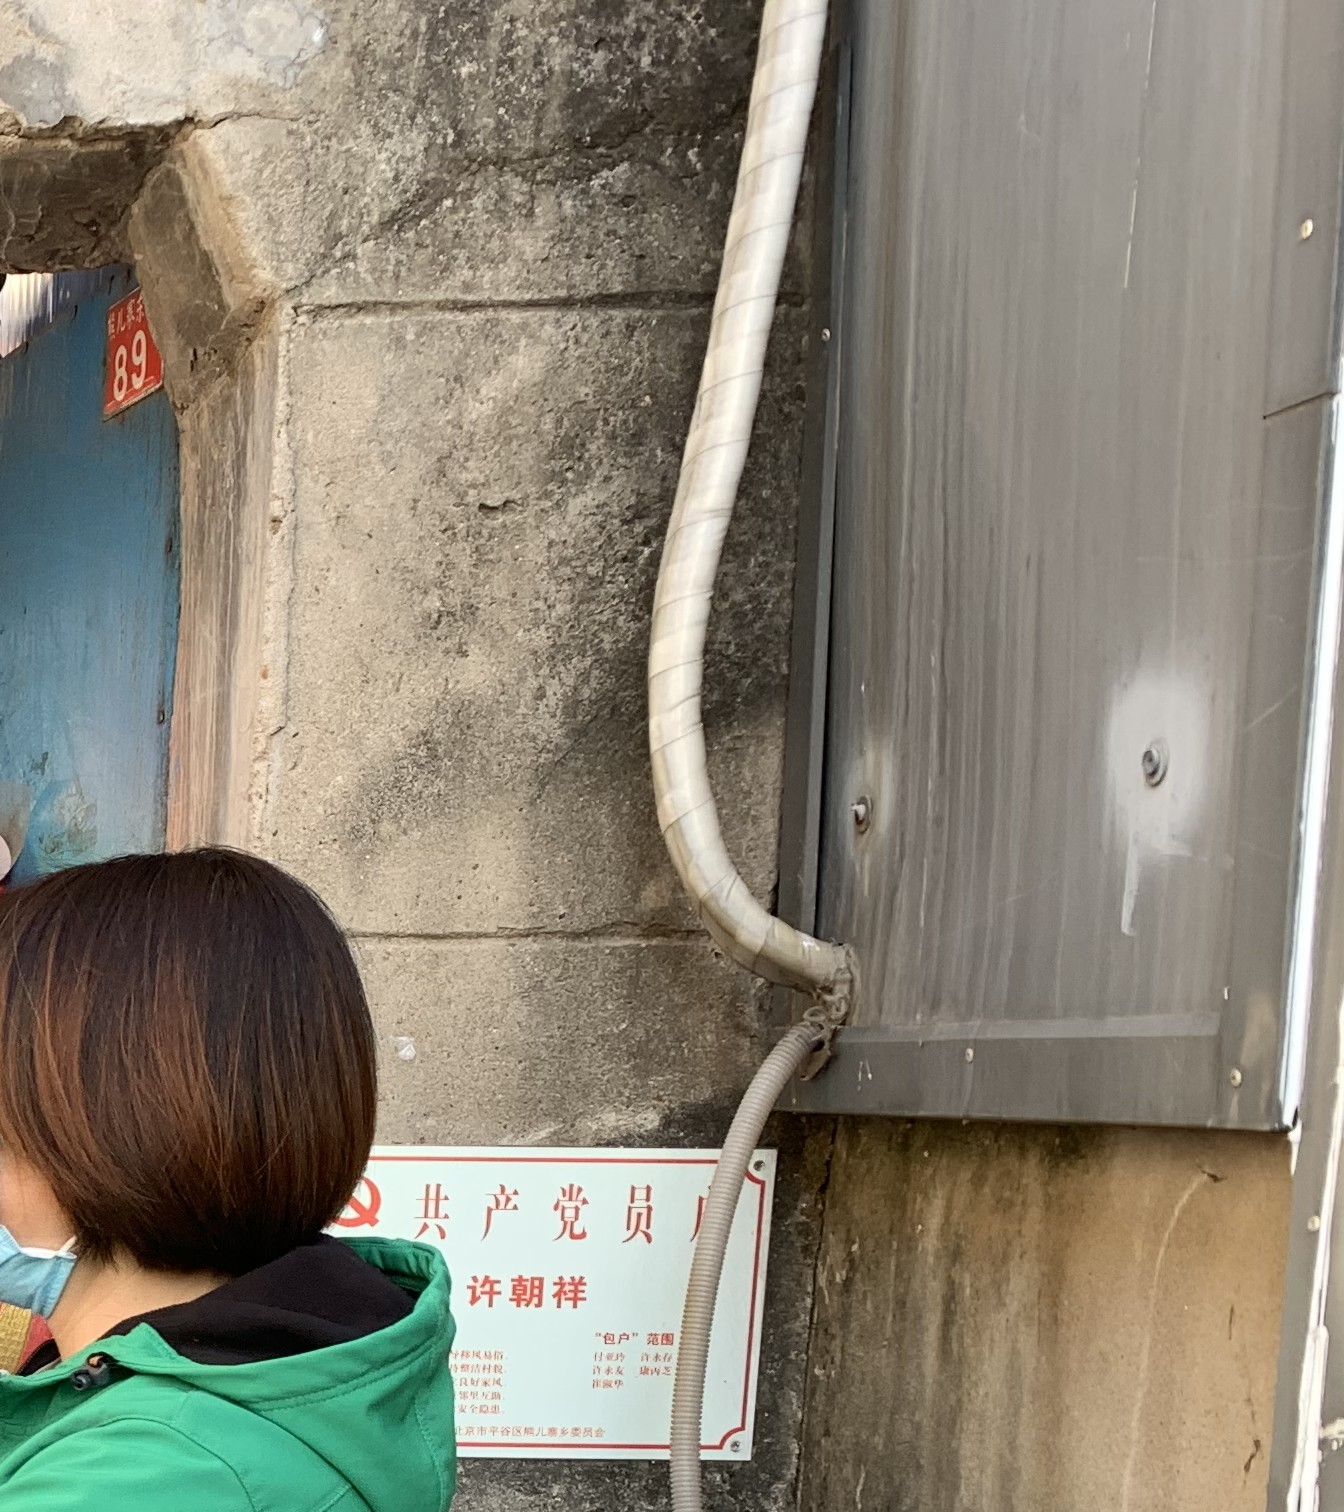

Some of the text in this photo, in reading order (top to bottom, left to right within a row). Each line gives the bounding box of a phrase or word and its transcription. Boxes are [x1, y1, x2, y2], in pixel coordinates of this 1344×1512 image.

[113, 330, 147, 401] 89
[467, 1275, 587, 1309] 许朝祥
[647, 1332, 674, 1346] 范围
